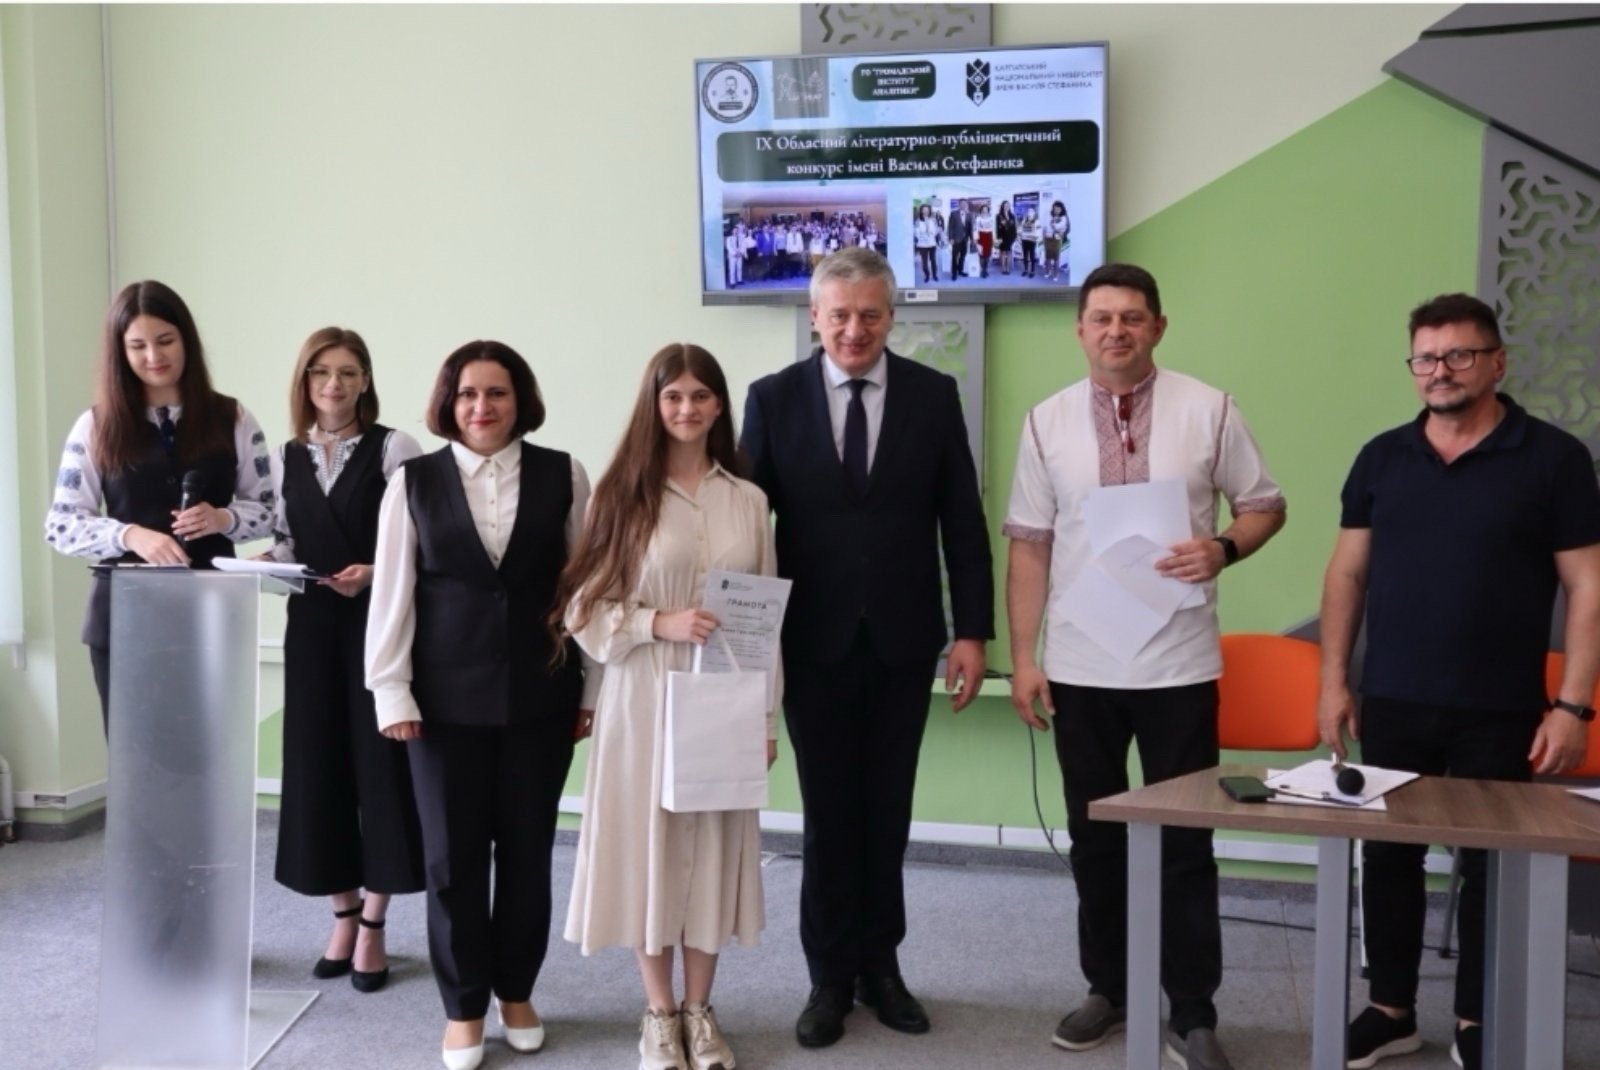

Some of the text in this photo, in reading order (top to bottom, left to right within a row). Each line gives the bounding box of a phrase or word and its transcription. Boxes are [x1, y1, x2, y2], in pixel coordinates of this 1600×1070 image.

[776, 135, 846, 150] Обласний
[851, 129, 1062, 150] літературно-публіцистичний
[787, 154, 1024, 178] конкурс імені Василя Стефаника
[727, 598, 767, 609] ГРАМОТА
